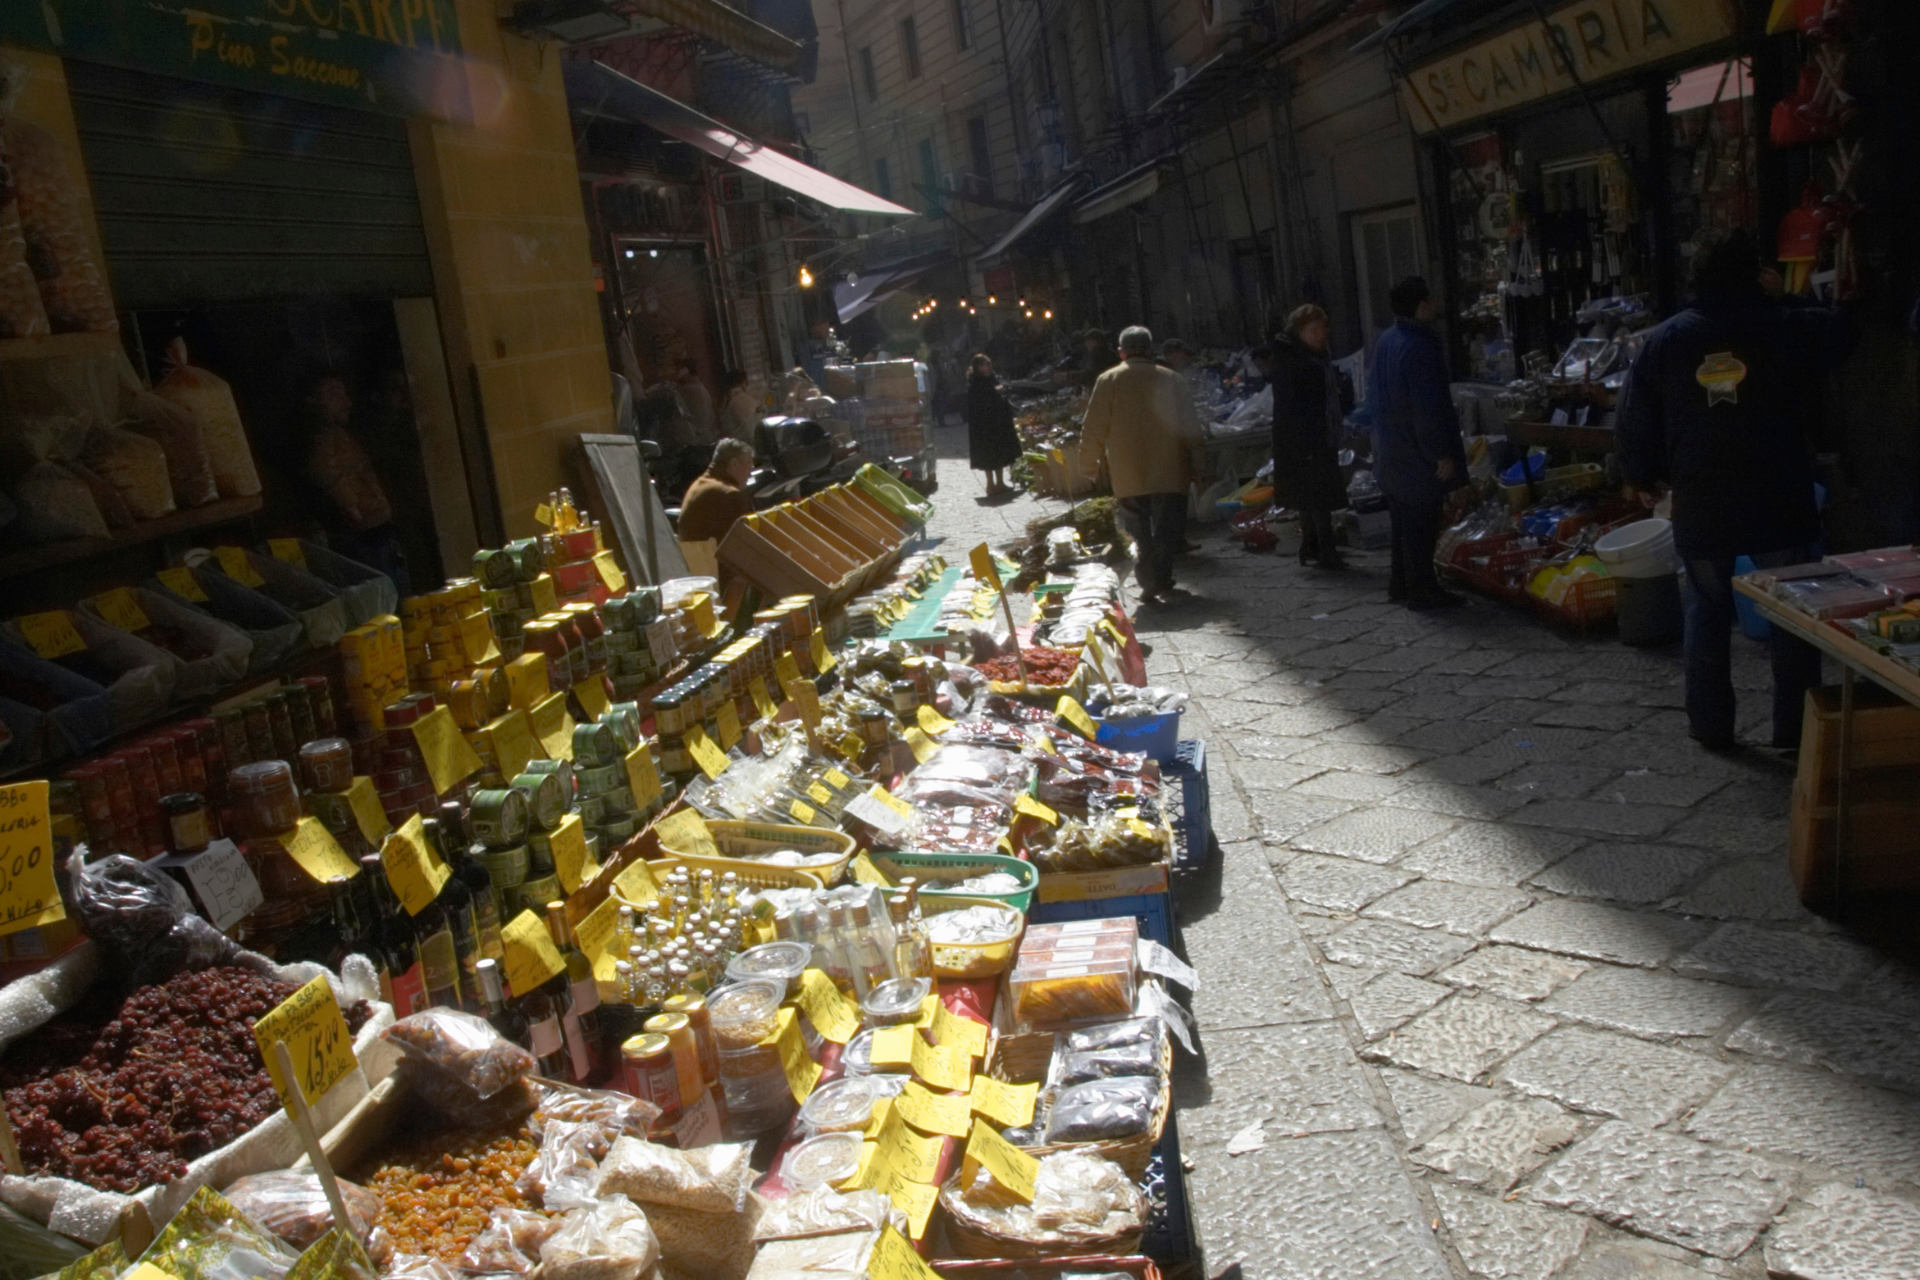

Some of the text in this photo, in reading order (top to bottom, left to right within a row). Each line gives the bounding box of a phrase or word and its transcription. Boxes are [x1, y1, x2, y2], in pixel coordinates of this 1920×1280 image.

[185, 14, 256, 67] Pino
[1462, 0, 1672, 101] CAMBRIA
[1086, 883, 1117, 893] DATTE
[256, 983, 321, 1036] UVA PASSA
